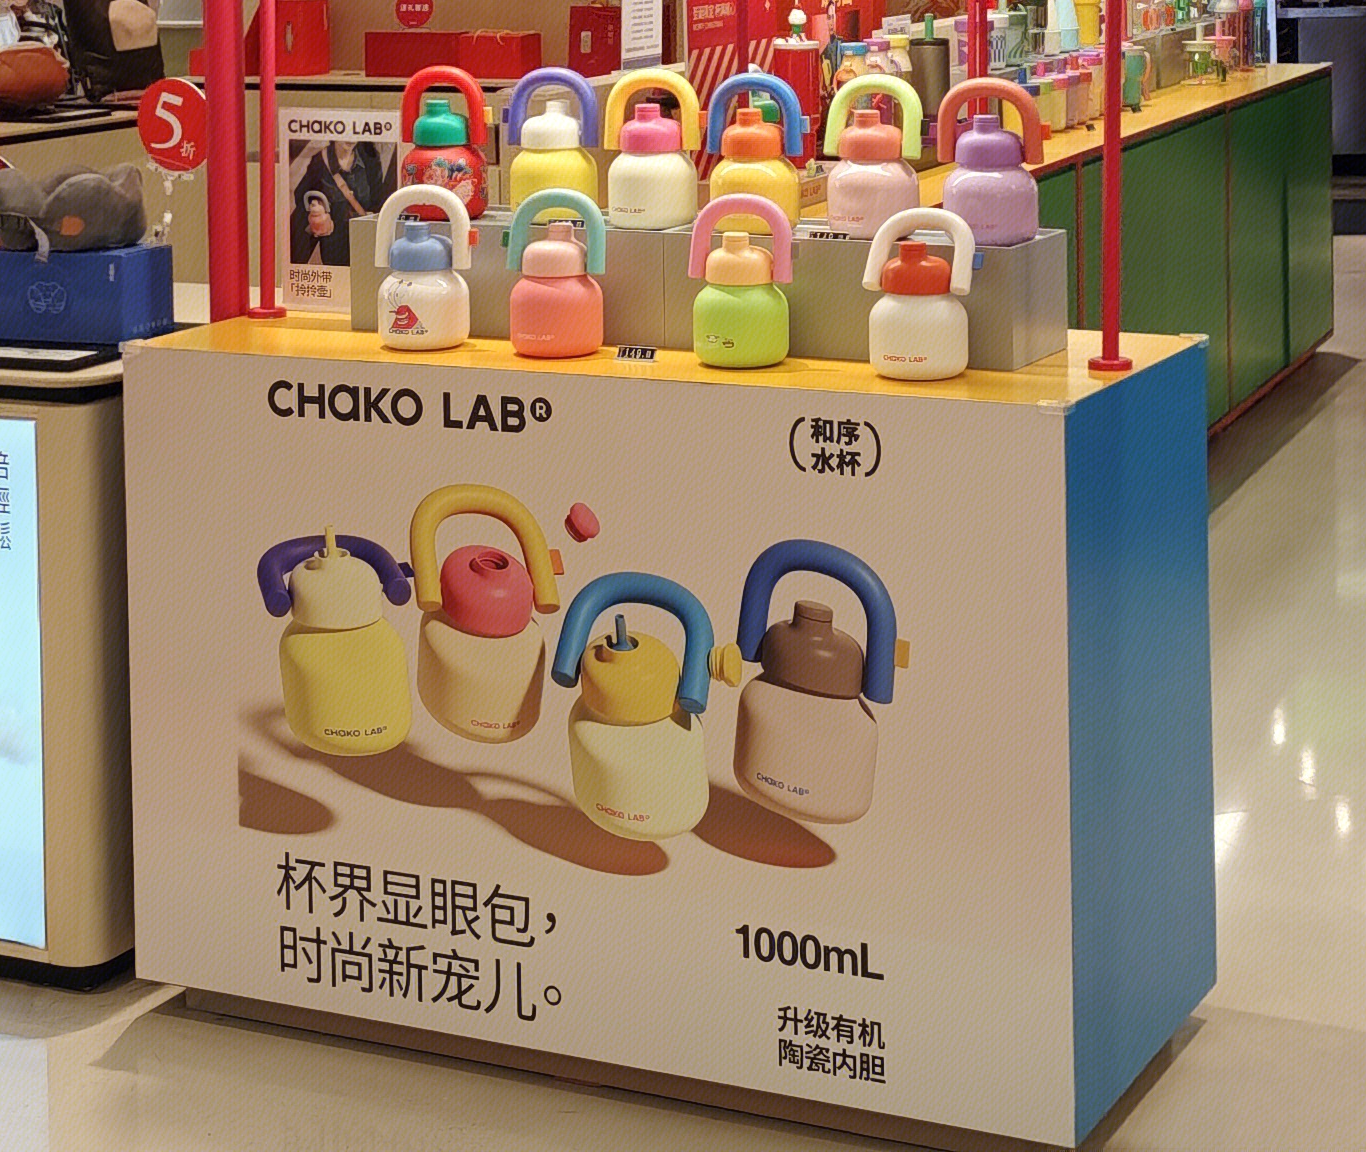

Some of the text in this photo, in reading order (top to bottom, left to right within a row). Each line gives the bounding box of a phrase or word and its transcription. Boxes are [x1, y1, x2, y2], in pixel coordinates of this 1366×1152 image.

[289, 269, 333, 284] 时尚外带
[735, 924, 886, 982] 1000mL
[777, 1005, 885, 1051] 升级有机
[777, 1038, 887, 1085] 陶瓷内胆
